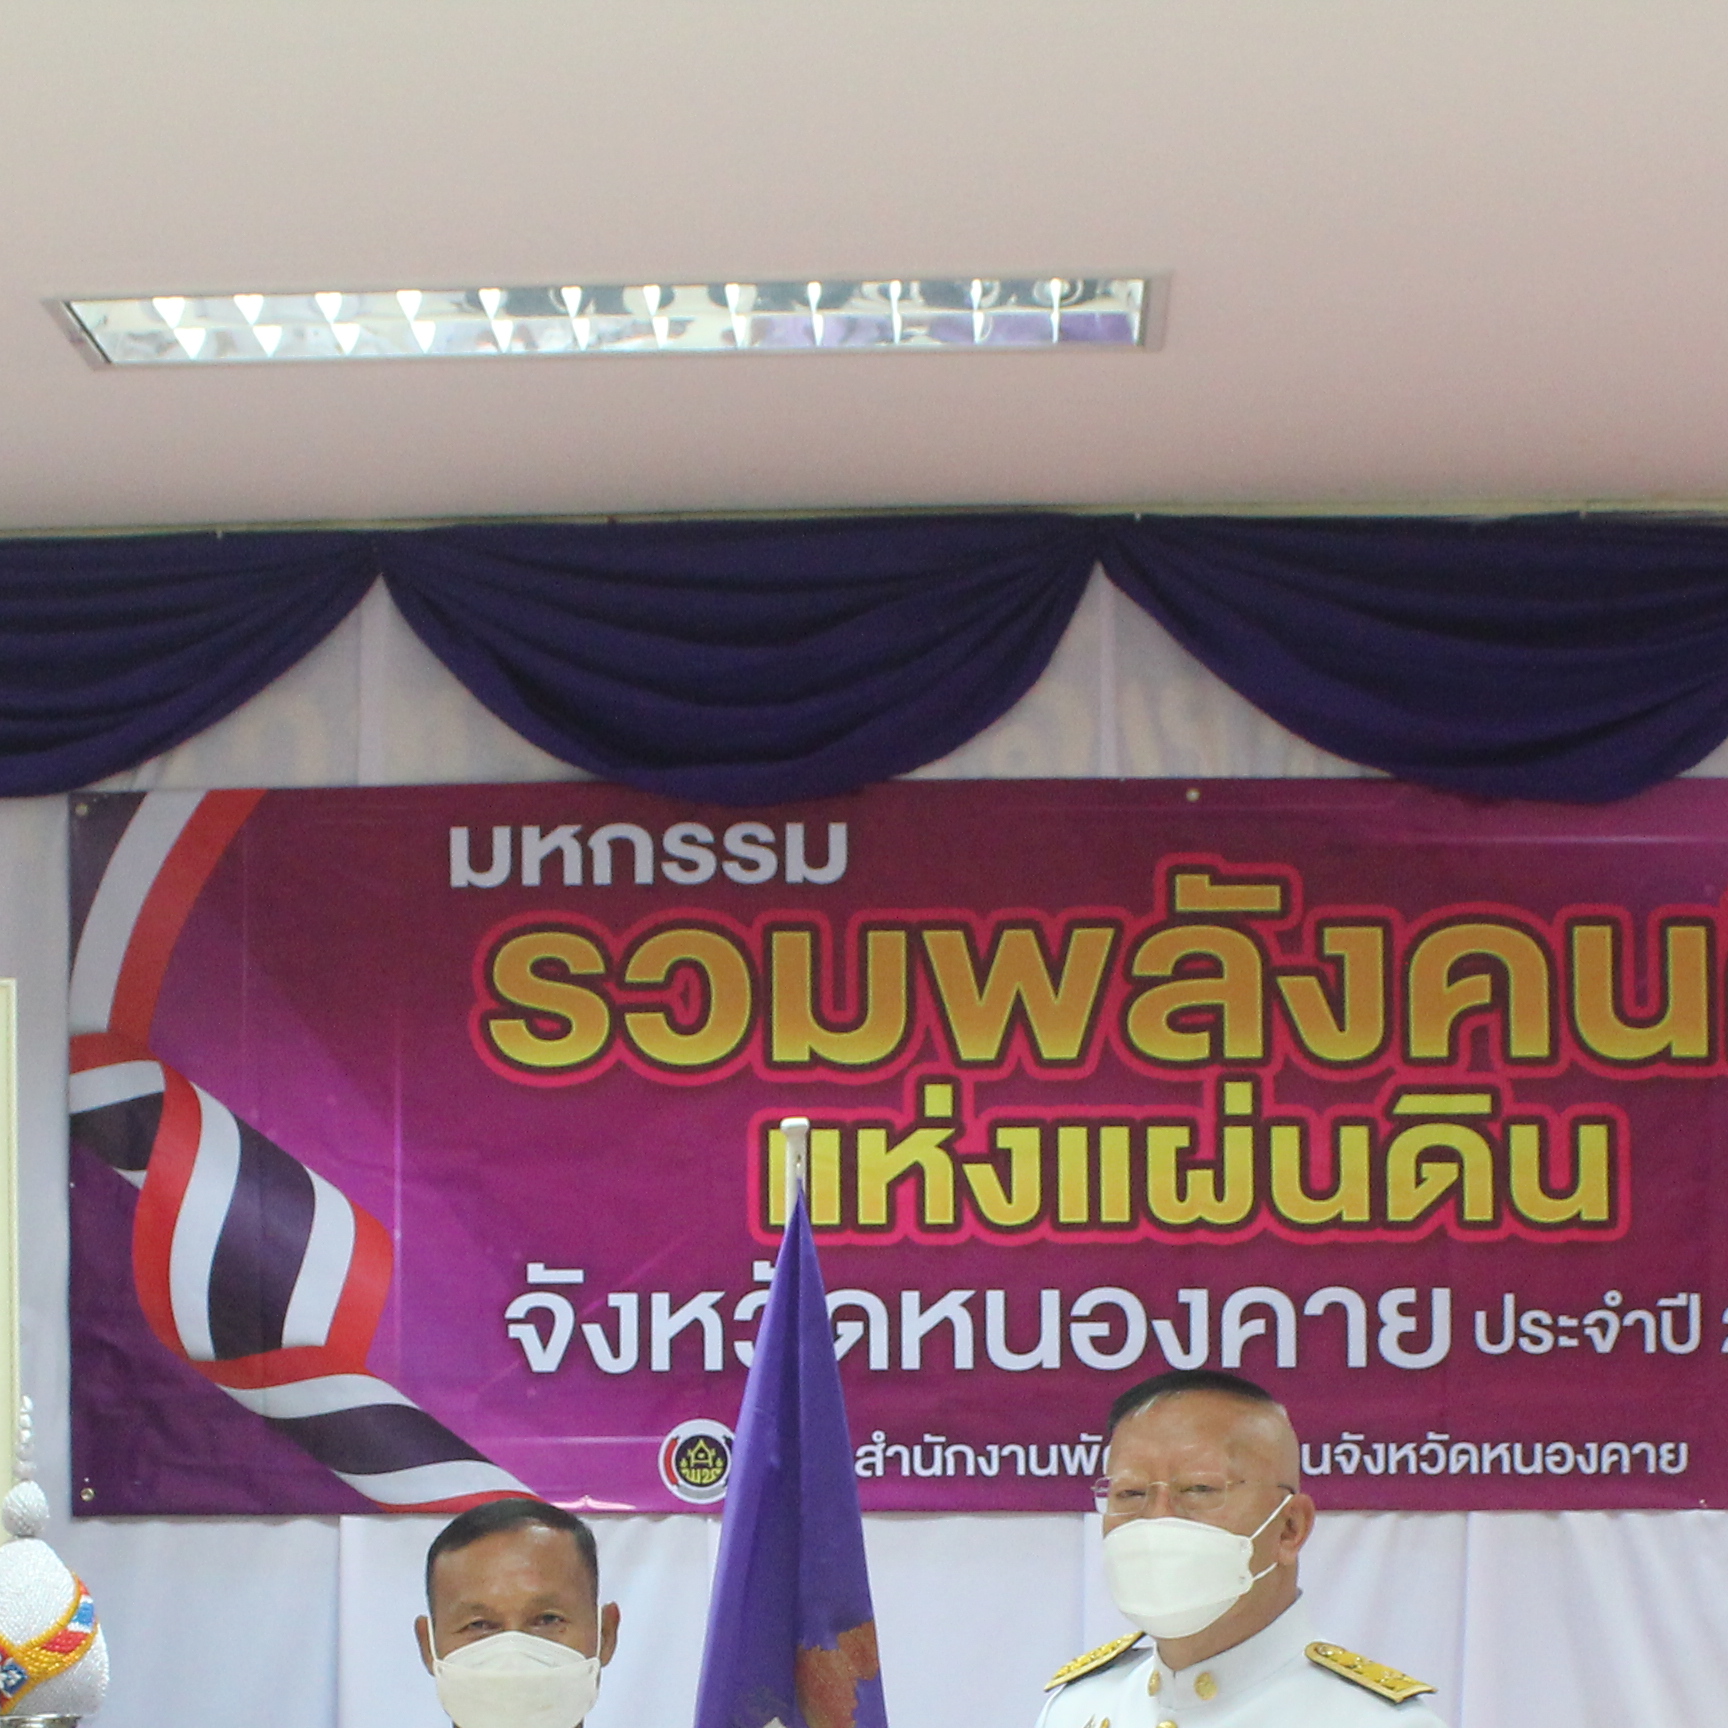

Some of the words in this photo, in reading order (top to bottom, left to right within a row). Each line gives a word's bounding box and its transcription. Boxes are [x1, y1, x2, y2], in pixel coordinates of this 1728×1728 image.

[449, 821, 848, 888] มหกรรม
[768, 1080, 1610, 1226] แห่งแผ่นดิน
[1474, 1290, 1702, 1355] ประจำปี
